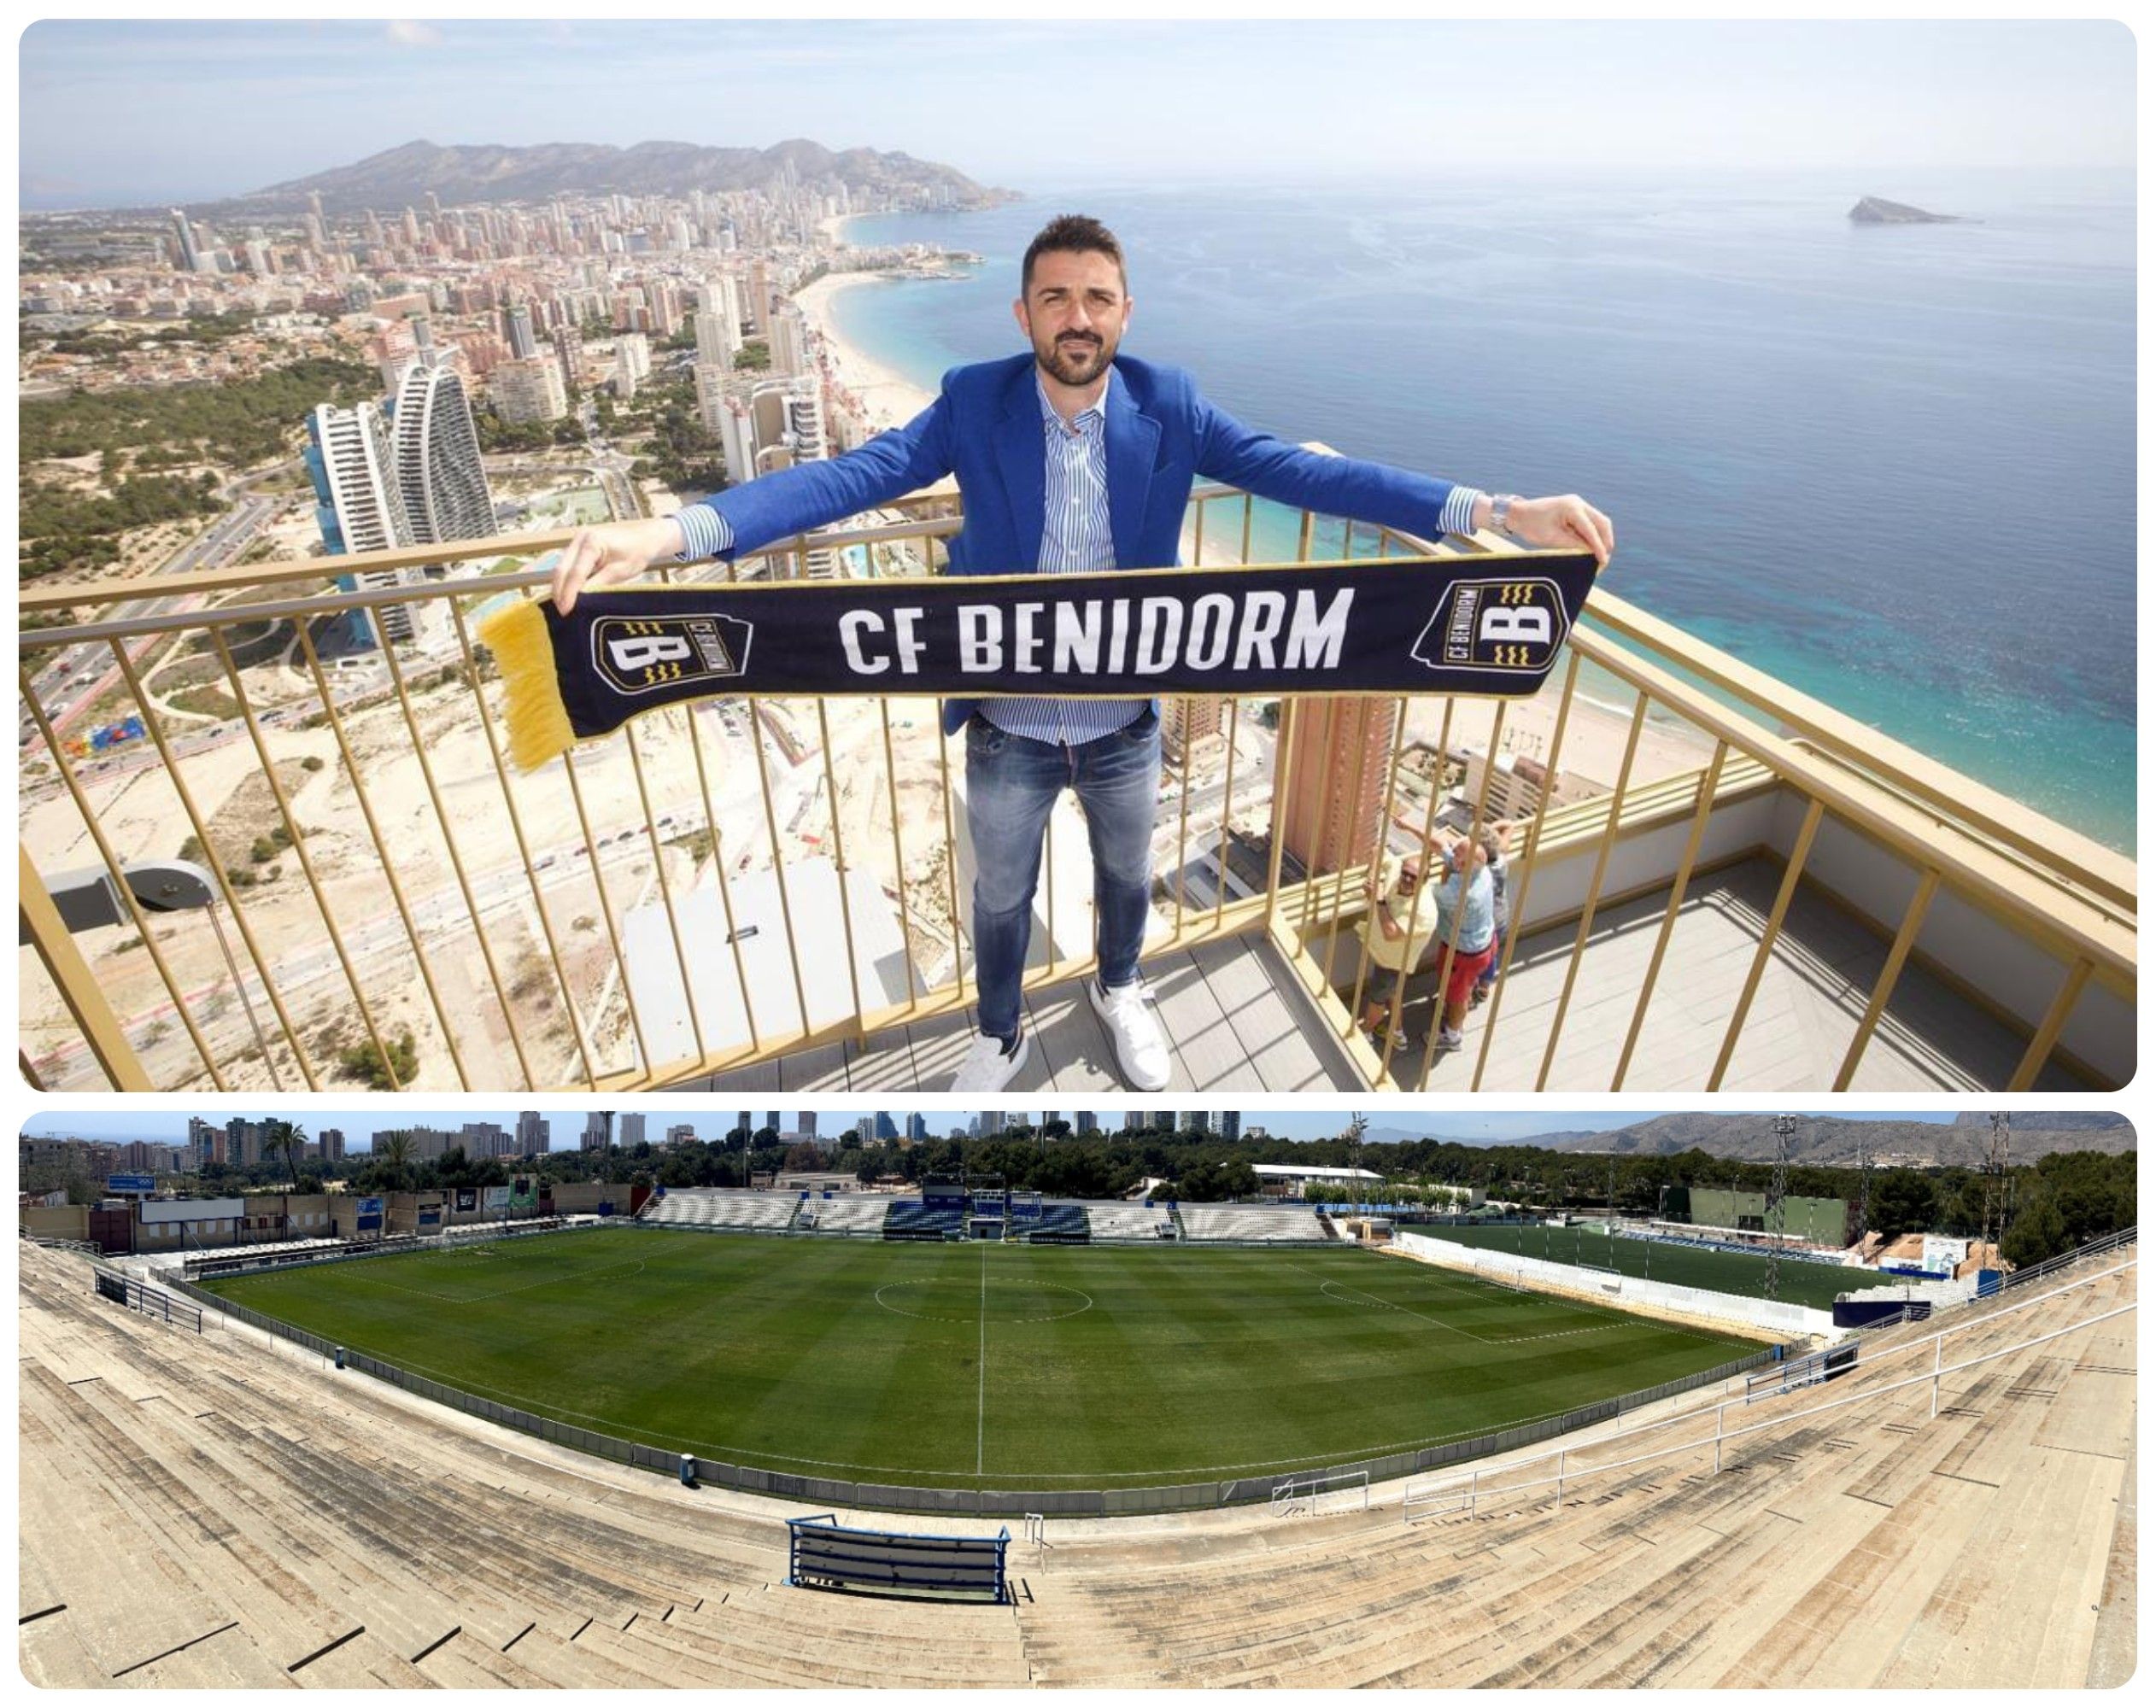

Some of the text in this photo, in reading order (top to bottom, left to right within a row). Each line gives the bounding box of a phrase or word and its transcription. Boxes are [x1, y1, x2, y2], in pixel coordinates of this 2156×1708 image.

[838, 588, 1356, 675] CF BENIDORM
[1480, 606, 1551, 645] B
[608, 636, 691, 671] B
